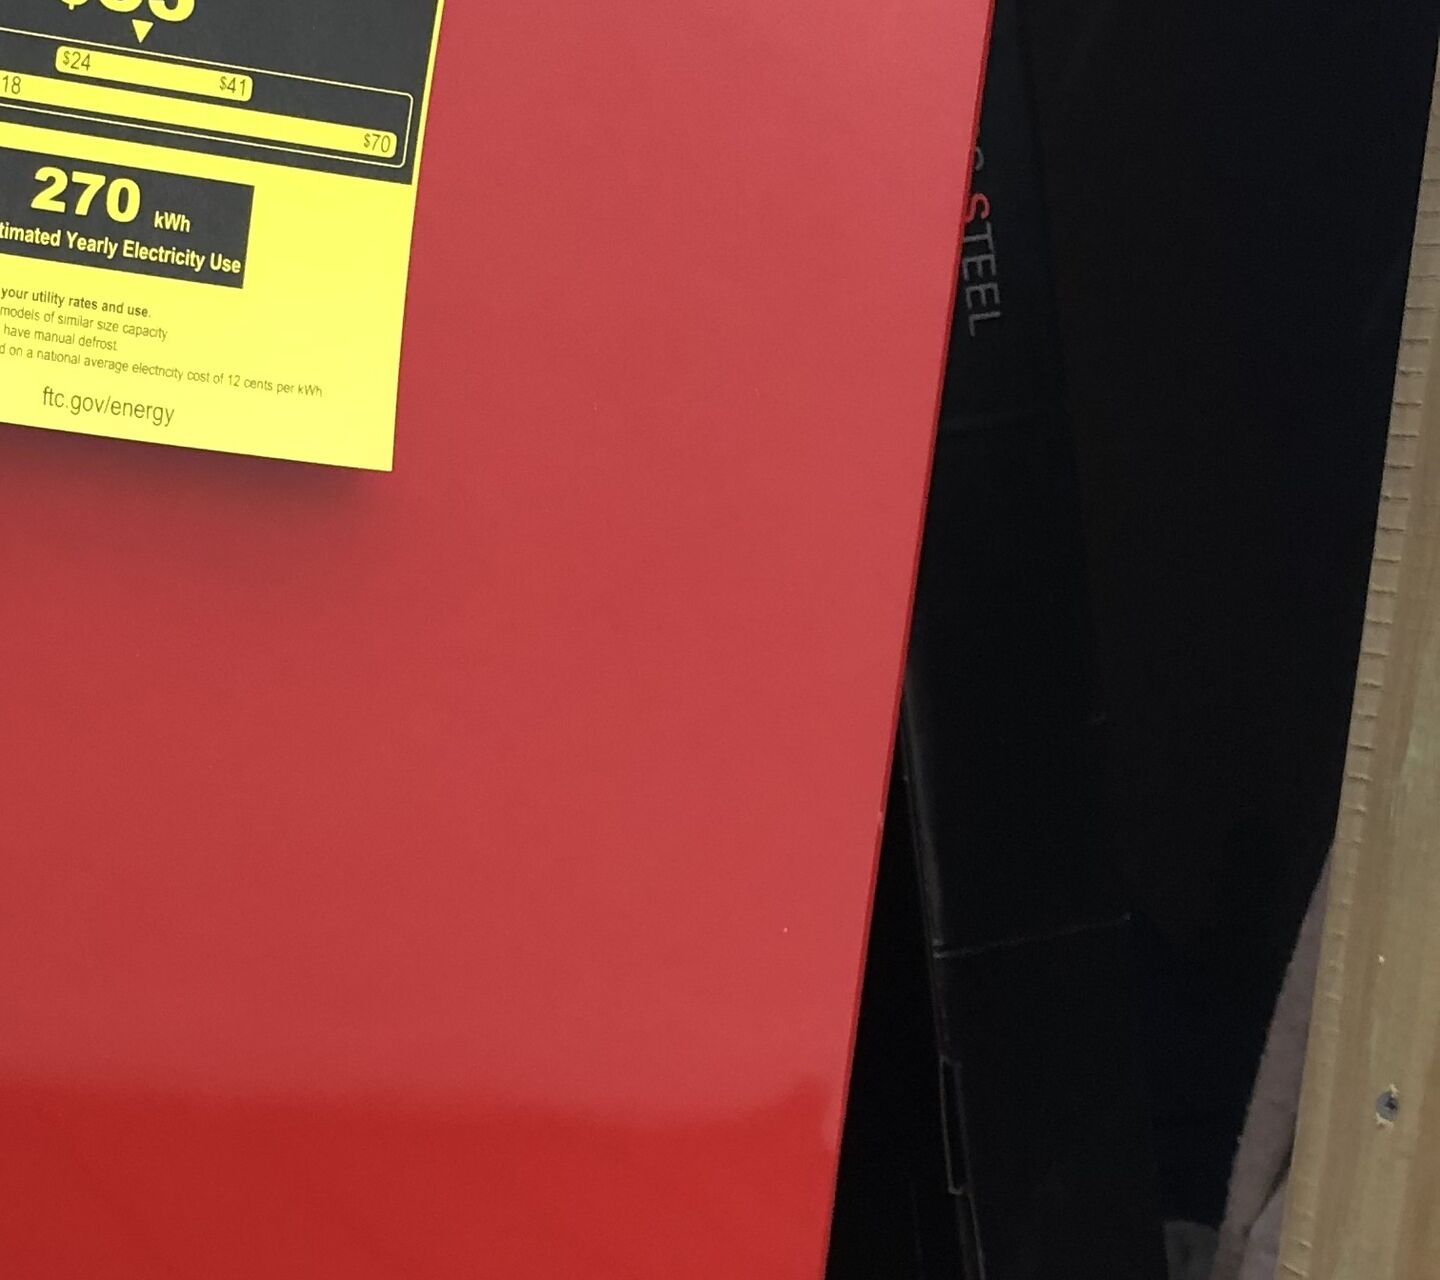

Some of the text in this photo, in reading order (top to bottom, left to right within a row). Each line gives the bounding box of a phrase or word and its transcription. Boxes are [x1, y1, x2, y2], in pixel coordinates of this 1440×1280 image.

[62, 50, 90, 70] $24
[219, 75, 245, 95] $41
[363, 132, 390, 153] $70
[30, 166, 190, 232] 270 kWh
[66, 230, 118, 259] Yearly
[122, 239, 205, 272] Electricity
[209, 252, 241, 273] Use
[963, 191, 1002, 338] STEEL
[0, 287, 28, 299] your
[31, 290, 65, 308] utility
[68, 296, 97, 310] rates
[101, 302, 124, 313] and
[127, 306, 151, 318] use.
[0, 306, 39, 321] models
[43, 310, 55, 322] of
[57, 314, 93, 328] similar
[96, 320, 118, 332] size
[122, 324, 167, 342] capacity
[3, 323, 30, 338] have
[33, 330, 75, 344] manual
[77, 335, 117, 351] defrost
[8, 346, 22, 356] on
[36, 349, 80, 364] national
[83, 356, 128, 373] average
[131, 362, 183, 381] electricity
[186, 370, 209, 382] cost
[212, 372, 223, 384] of
[228, 374, 240, 387] 12
[243, 378, 273, 391] cents
[276, 383, 294, 394] per
[297, 384, 322, 396] kWh
[42, 385, 174, 427] ftc.gov/energy
